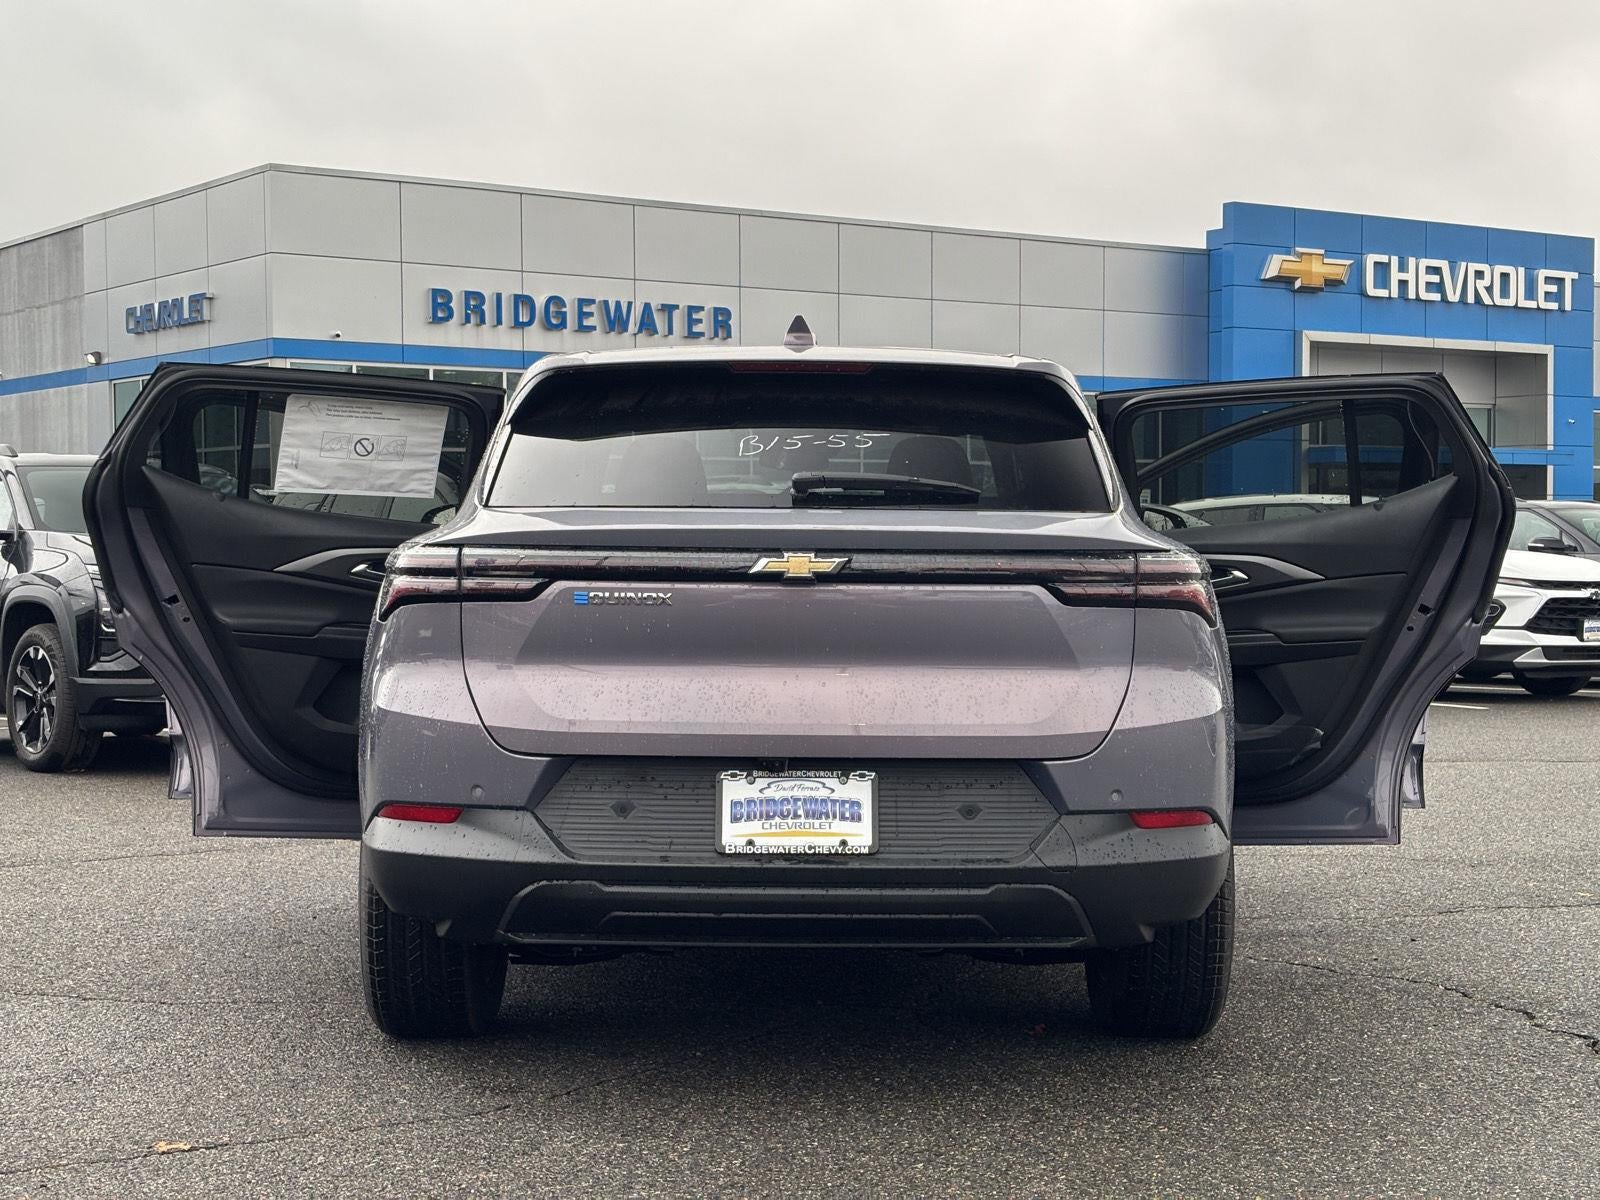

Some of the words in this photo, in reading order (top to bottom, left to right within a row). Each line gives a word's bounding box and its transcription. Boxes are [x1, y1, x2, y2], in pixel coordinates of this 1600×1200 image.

[1363, 253, 1578, 311] CHEVROLET
[125, 292, 211, 335] CHEVROLET
[428, 287, 734, 340] BRIDGEWATER
[573, 591, 674, 606] EQUINOX
[730, 795, 864, 824] BRIDGEWATER
[761, 821, 834, 830] CHEVROLET
